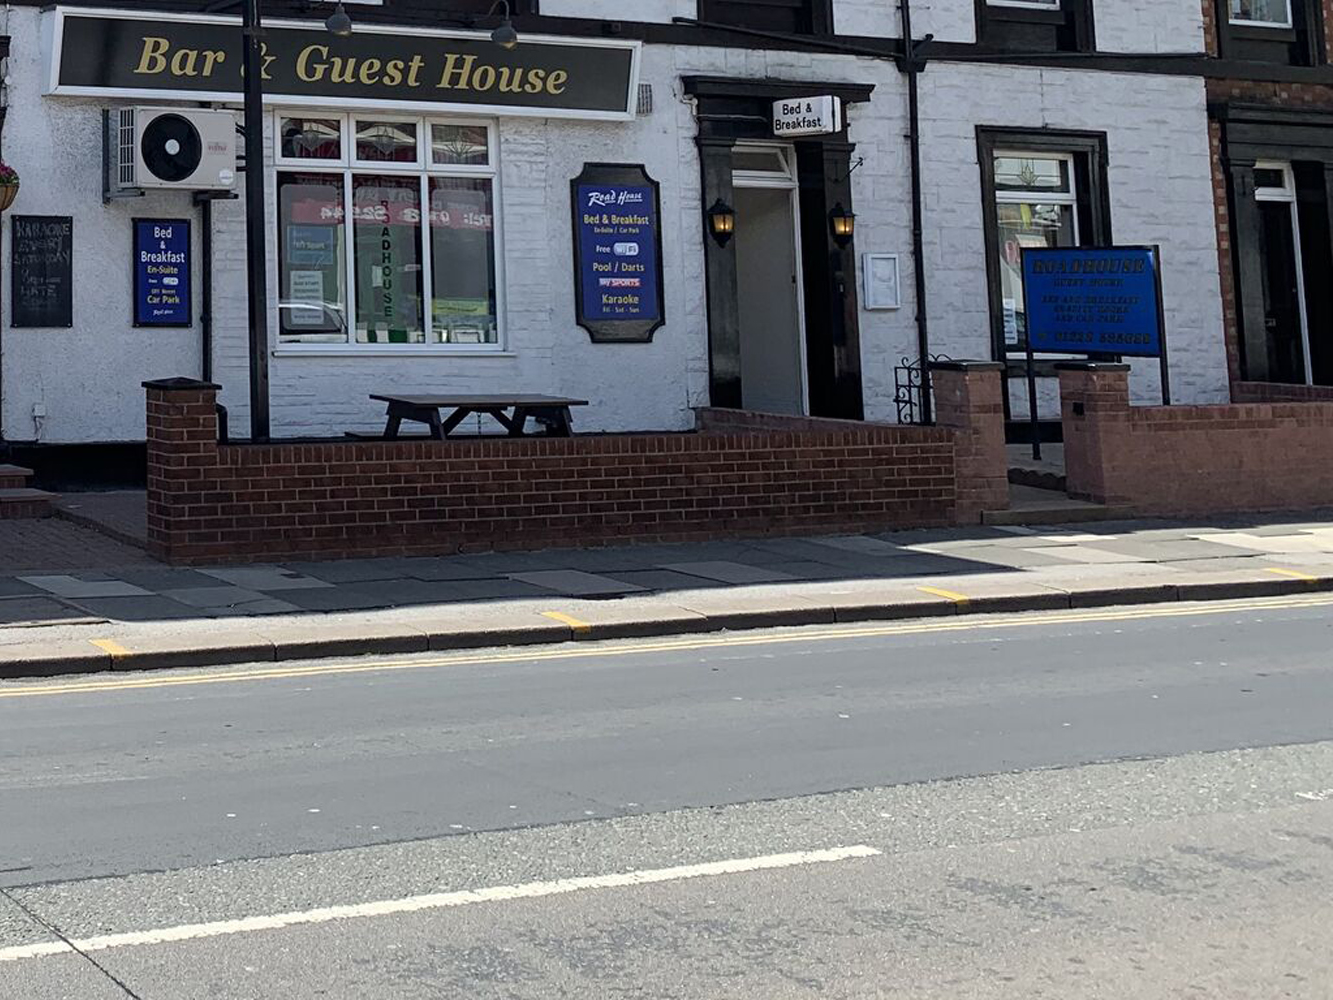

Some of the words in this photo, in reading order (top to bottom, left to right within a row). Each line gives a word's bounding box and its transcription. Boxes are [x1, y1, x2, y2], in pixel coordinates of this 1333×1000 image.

[134, 36, 226, 77] Bar
[295, 44, 425, 88] Guest
[437, 53, 568, 96] House
[782, 103, 801, 115] Bed
[805, 103, 812, 113] &
[775, 117, 821, 130] Breakfast
[588, 190, 616, 206] Road
[617, 191, 643, 205] House
[583, 214, 599, 224] Bed
[602, 214, 609, 224] &
[611, 214, 649, 225] Breakfast
[154, 226, 172, 238] Bed
[160, 240, 166, 249] &
[596, 245, 611, 253] Free
[141, 251, 185, 263] Breakfast
[147, 265, 178, 274] En-Suite
[593, 263, 612, 271] Pool
[621, 263, 645, 272] Darts
[147, 295, 161, 304] Car
[162, 295, 180, 304] Park
[602, 294, 639, 304] Karaoke
